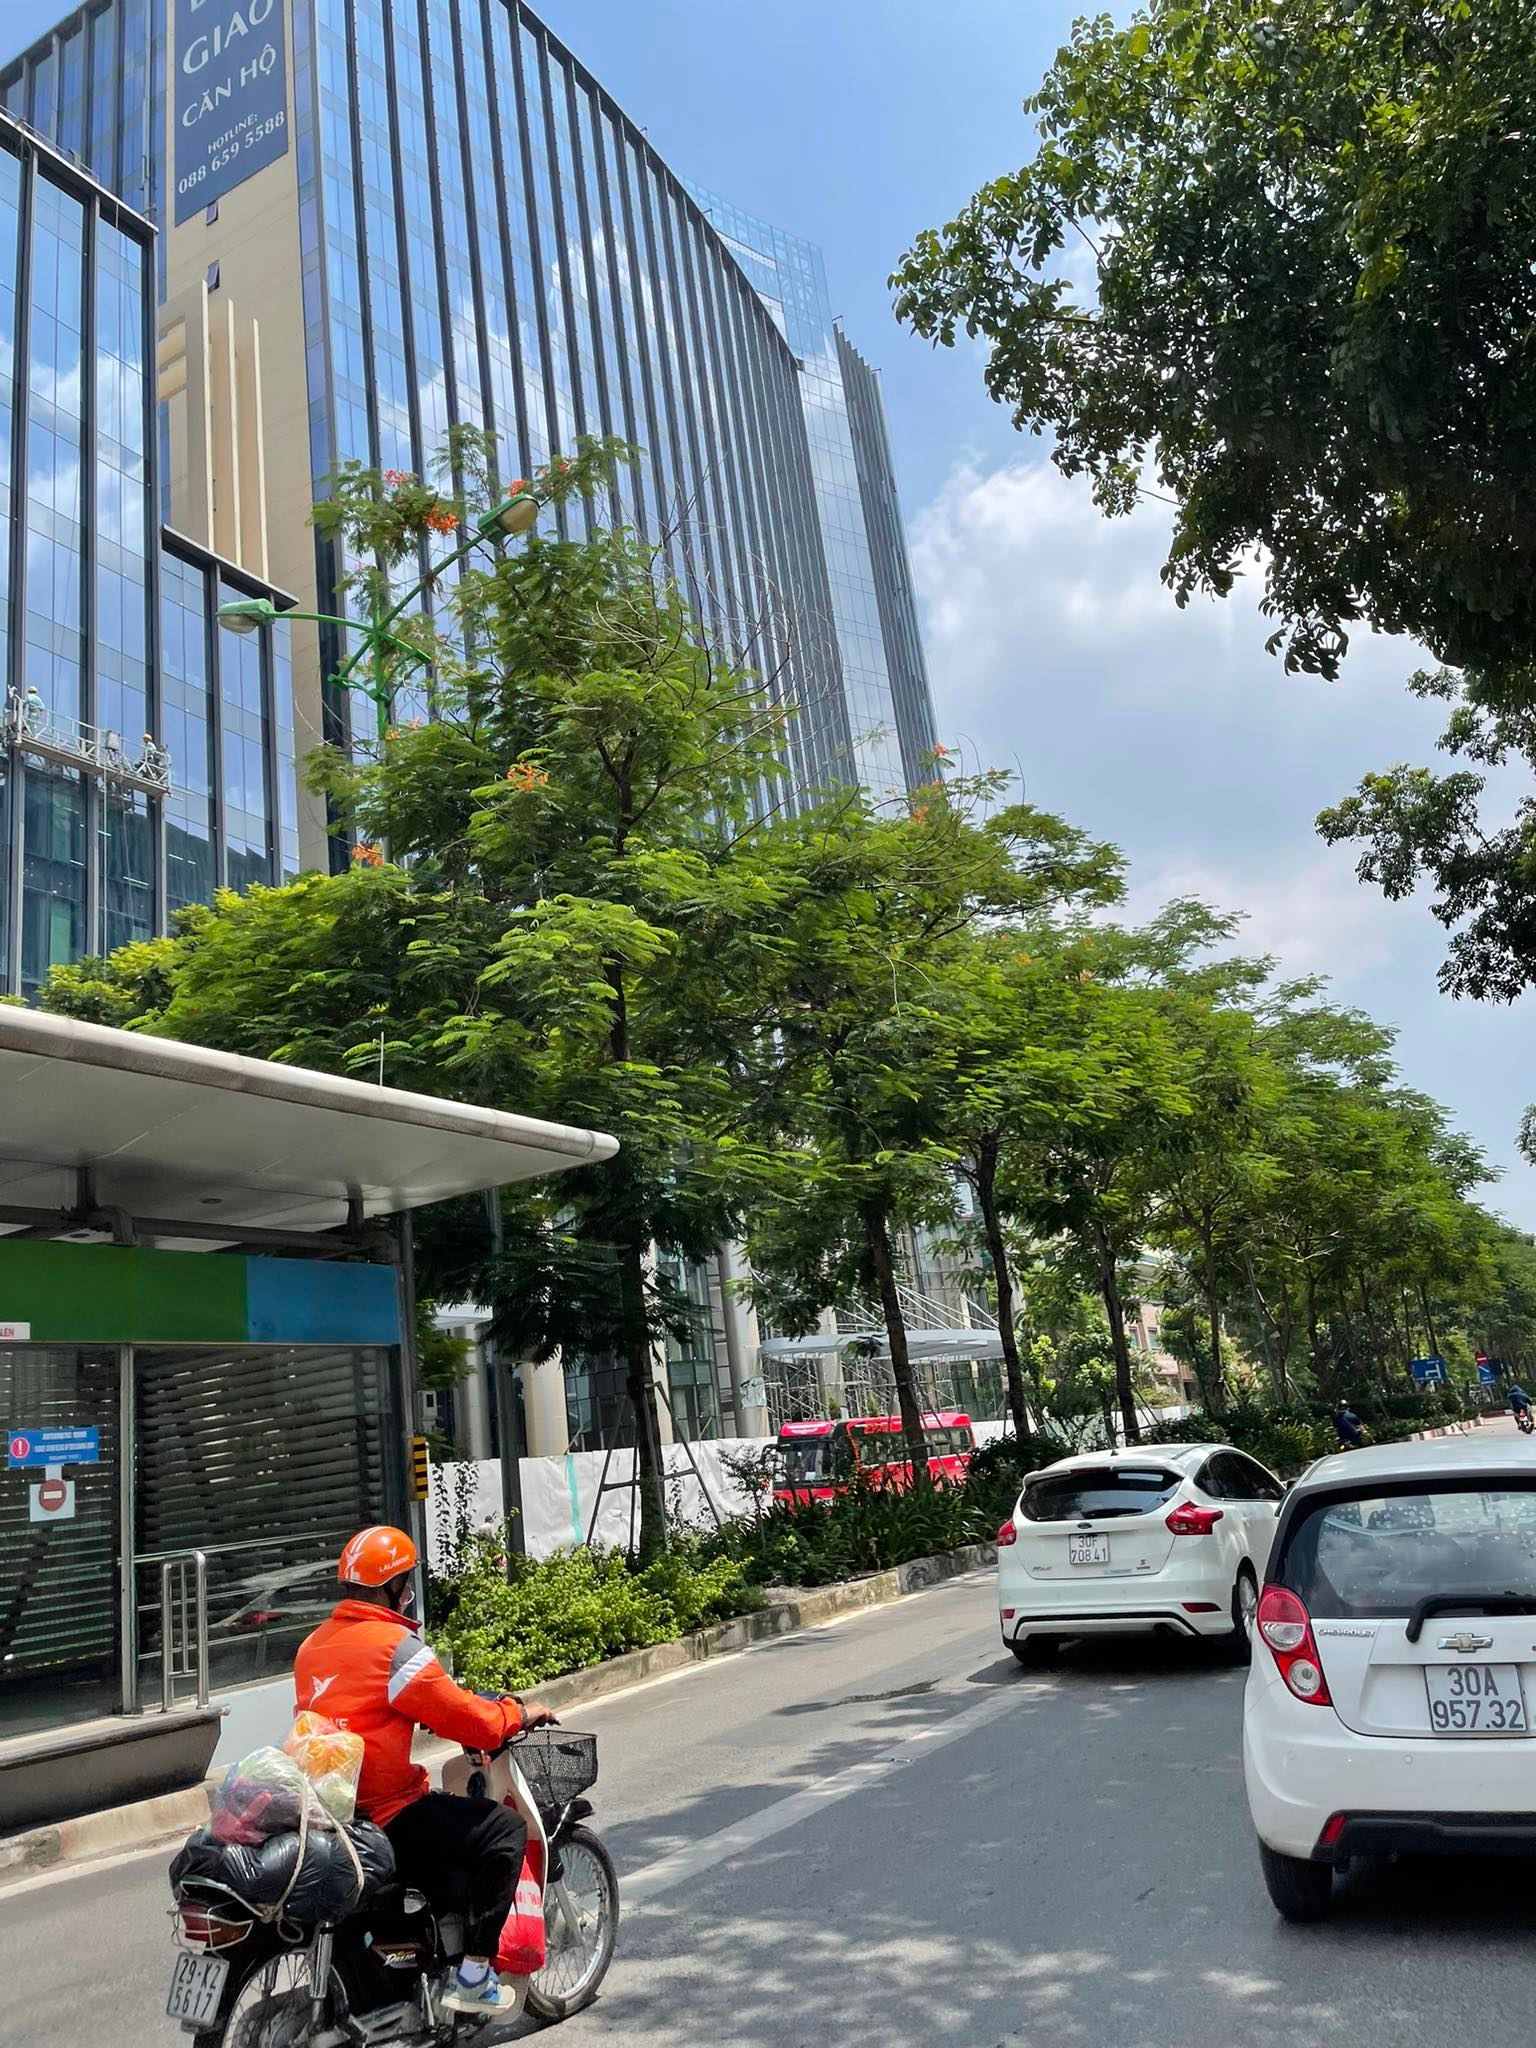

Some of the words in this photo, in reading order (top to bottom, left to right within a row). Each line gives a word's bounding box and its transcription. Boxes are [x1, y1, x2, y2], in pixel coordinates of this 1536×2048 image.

[183, 0, 273, 73] GIAO
[182, 77, 231, 127] CĂN
[240, 43, 277, 87] HỘ
[208, 113, 258, 154] HOTLINE:
[179, 165, 207, 194] 088
[211, 142, 239, 171] 659
[245, 111, 285, 149] 5588
[1078, 1535, 1098, 1548] 30F
[1447, 1667, 1499, 1697] 30A
[1432, 1700, 1524, 1729] 957.32
[174, 1986, 213, 2018] 5617
